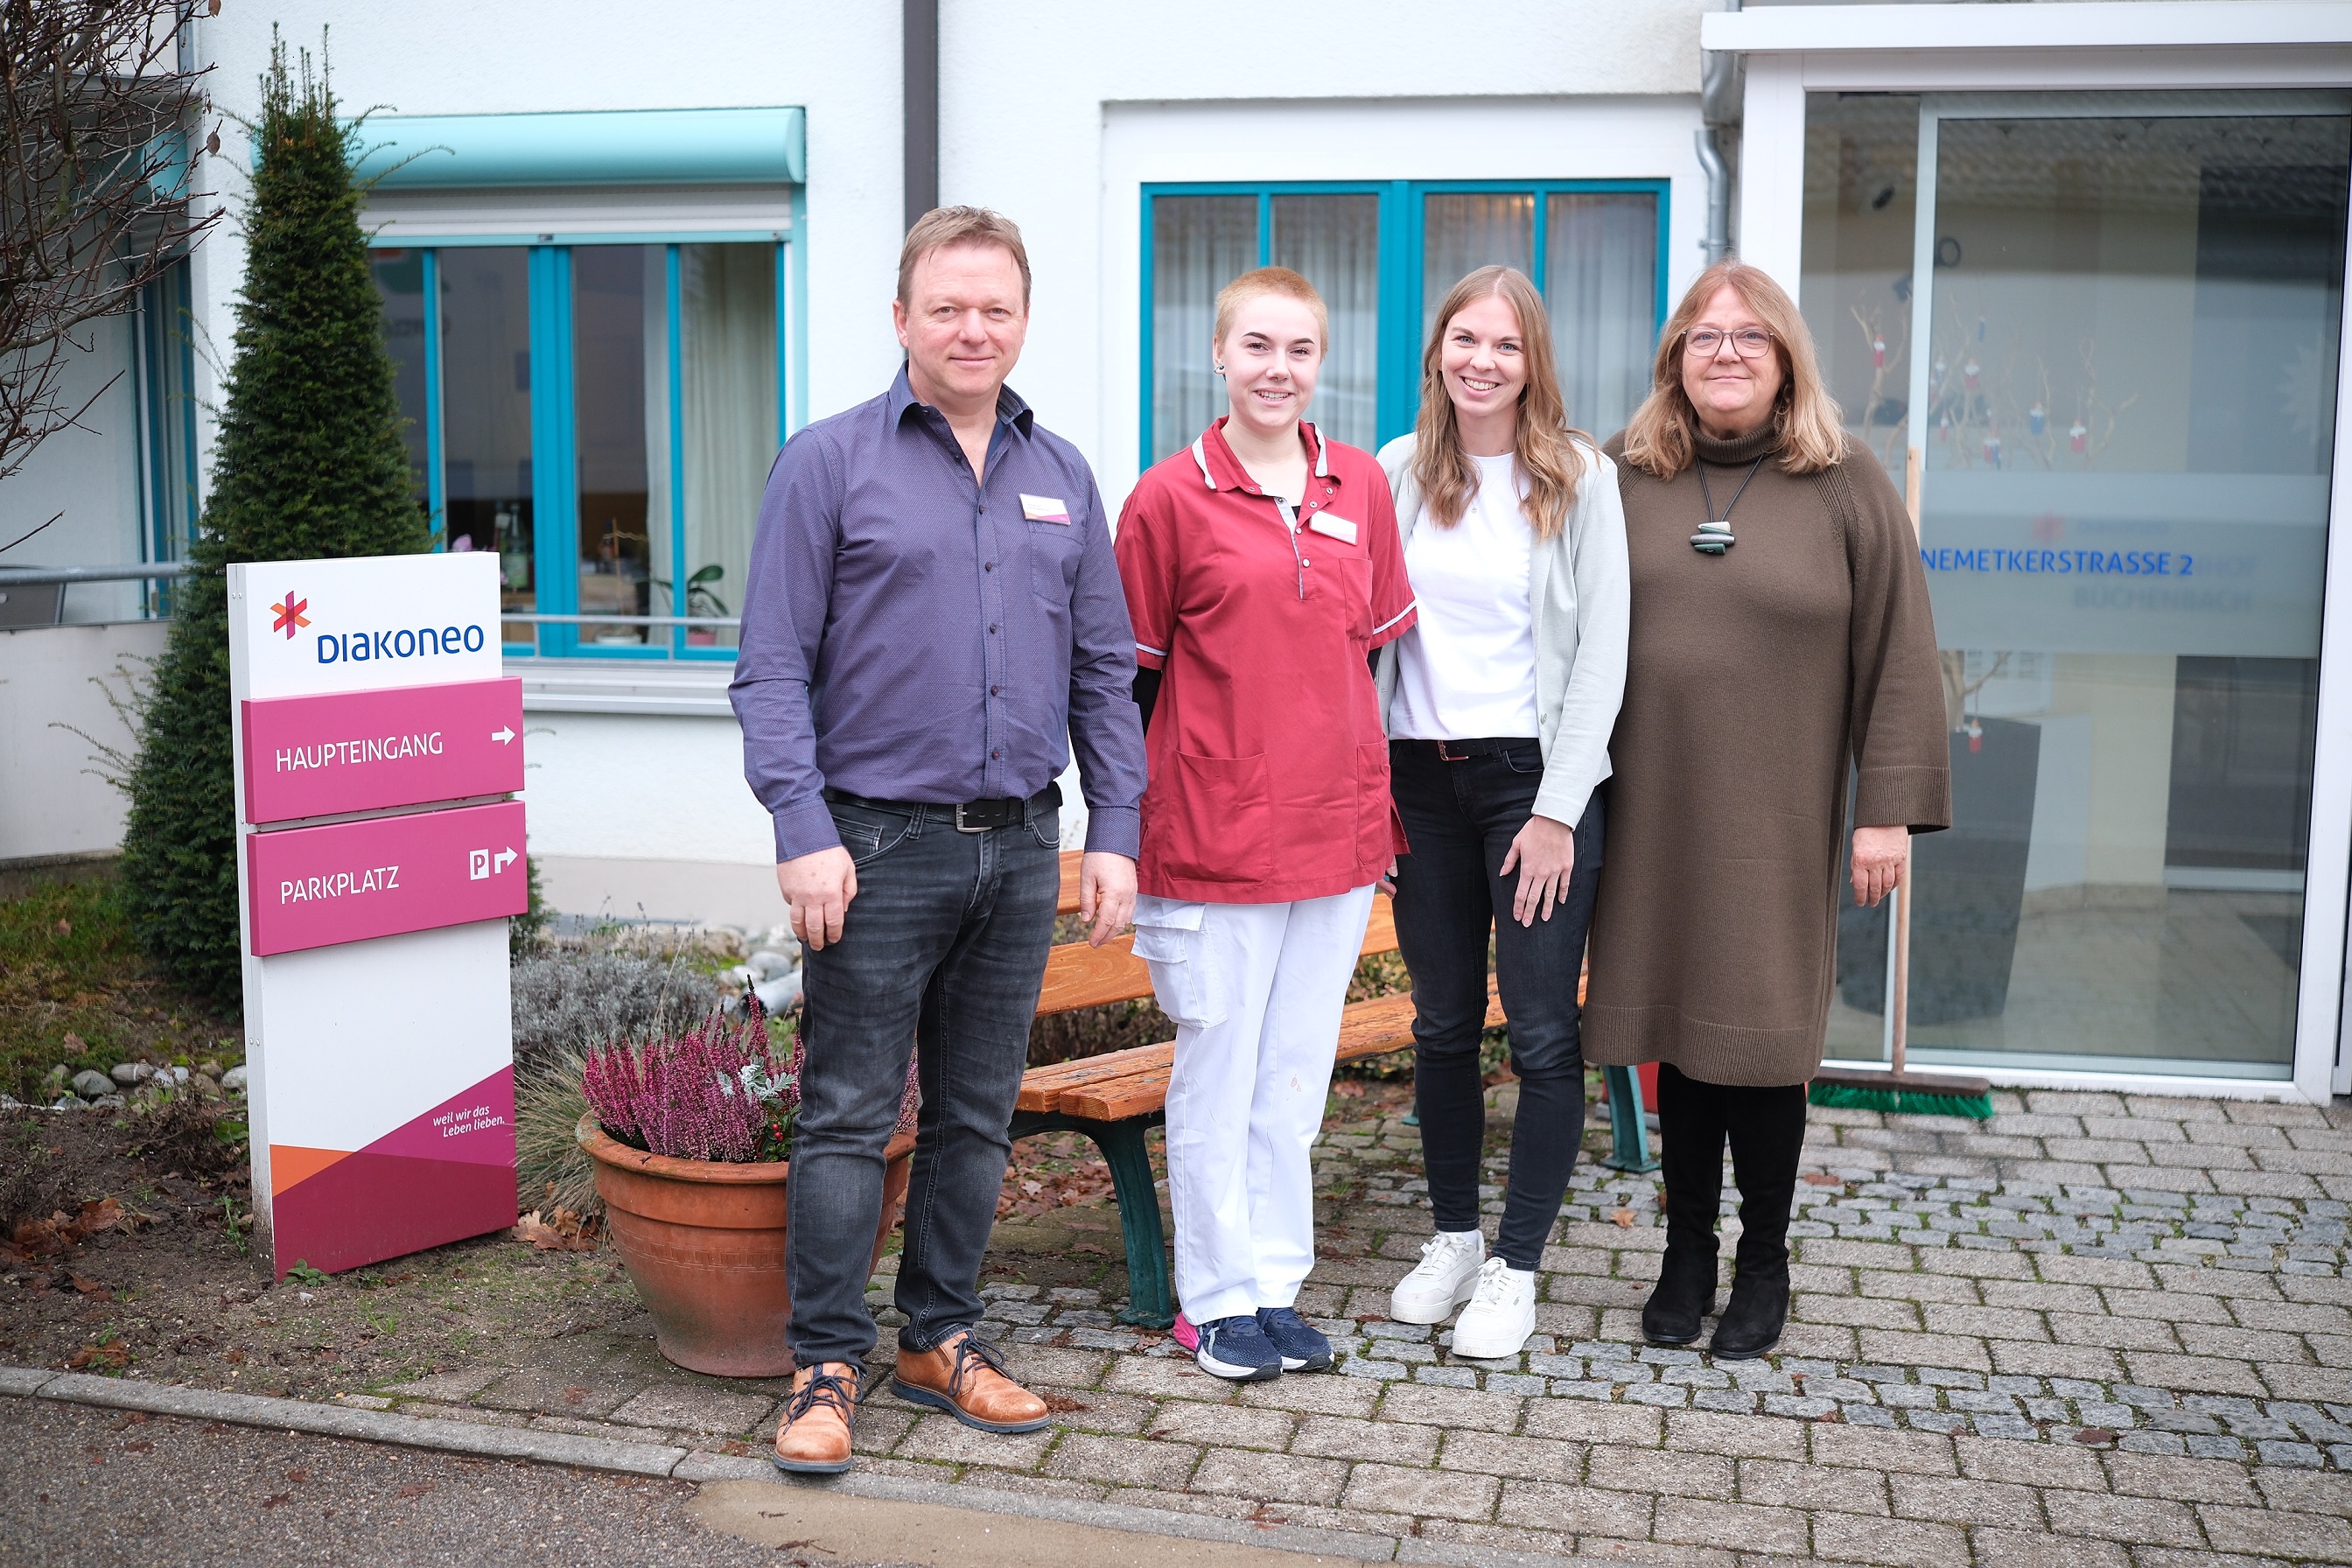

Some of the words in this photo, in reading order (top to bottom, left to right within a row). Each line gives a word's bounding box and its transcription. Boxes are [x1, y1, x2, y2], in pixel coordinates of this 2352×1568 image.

[1921, 549, 2171, 576] NEMETKERSTRASSE
[2180, 554, 2194, 577] 2
[276, 732, 443, 773] HAUPTEINGANG
[281, 865, 400, 905] PARKPLATZ
[432, 1110, 454, 1127] weil
[455, 1108, 472, 1122] wir
[472, 1105, 490, 1118] das
[443, 1123, 472, 1138] Leben
[473, 1116, 505, 1130] lieben.
